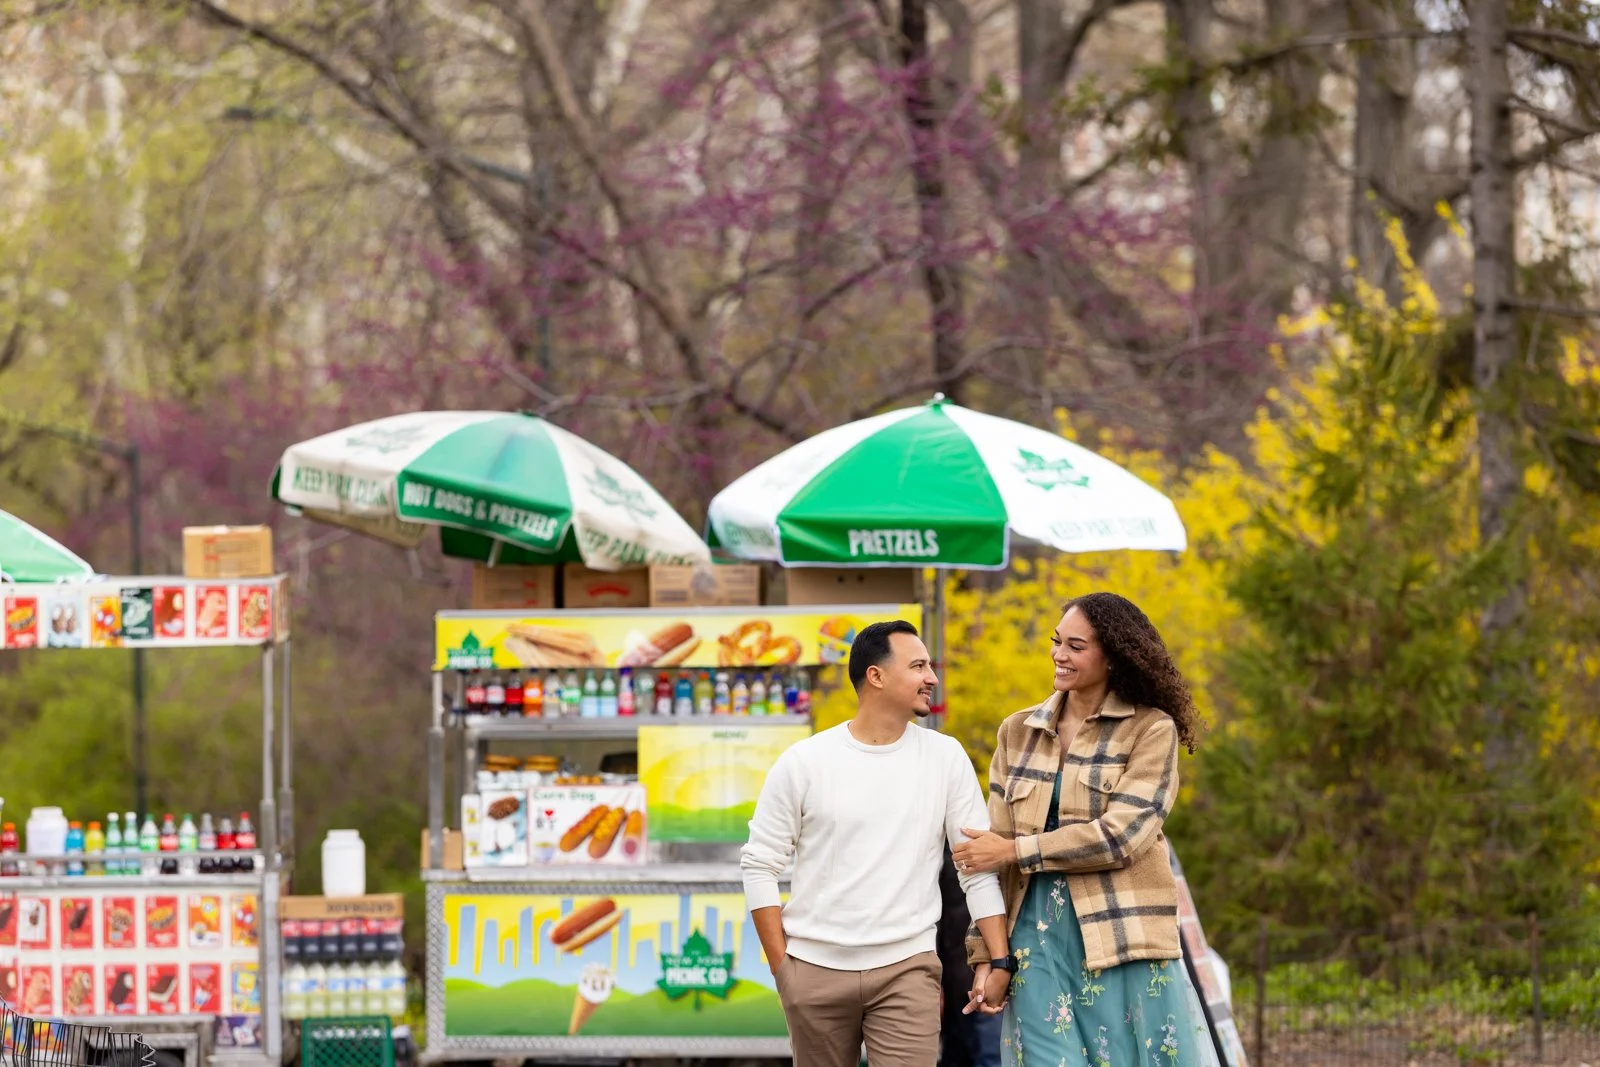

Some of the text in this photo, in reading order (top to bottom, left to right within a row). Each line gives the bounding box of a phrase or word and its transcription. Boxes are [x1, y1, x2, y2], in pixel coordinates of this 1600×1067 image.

[402, 481, 558, 541] HOT DOGS & PRETZELS
[848, 529, 940, 557] PRETZELS
